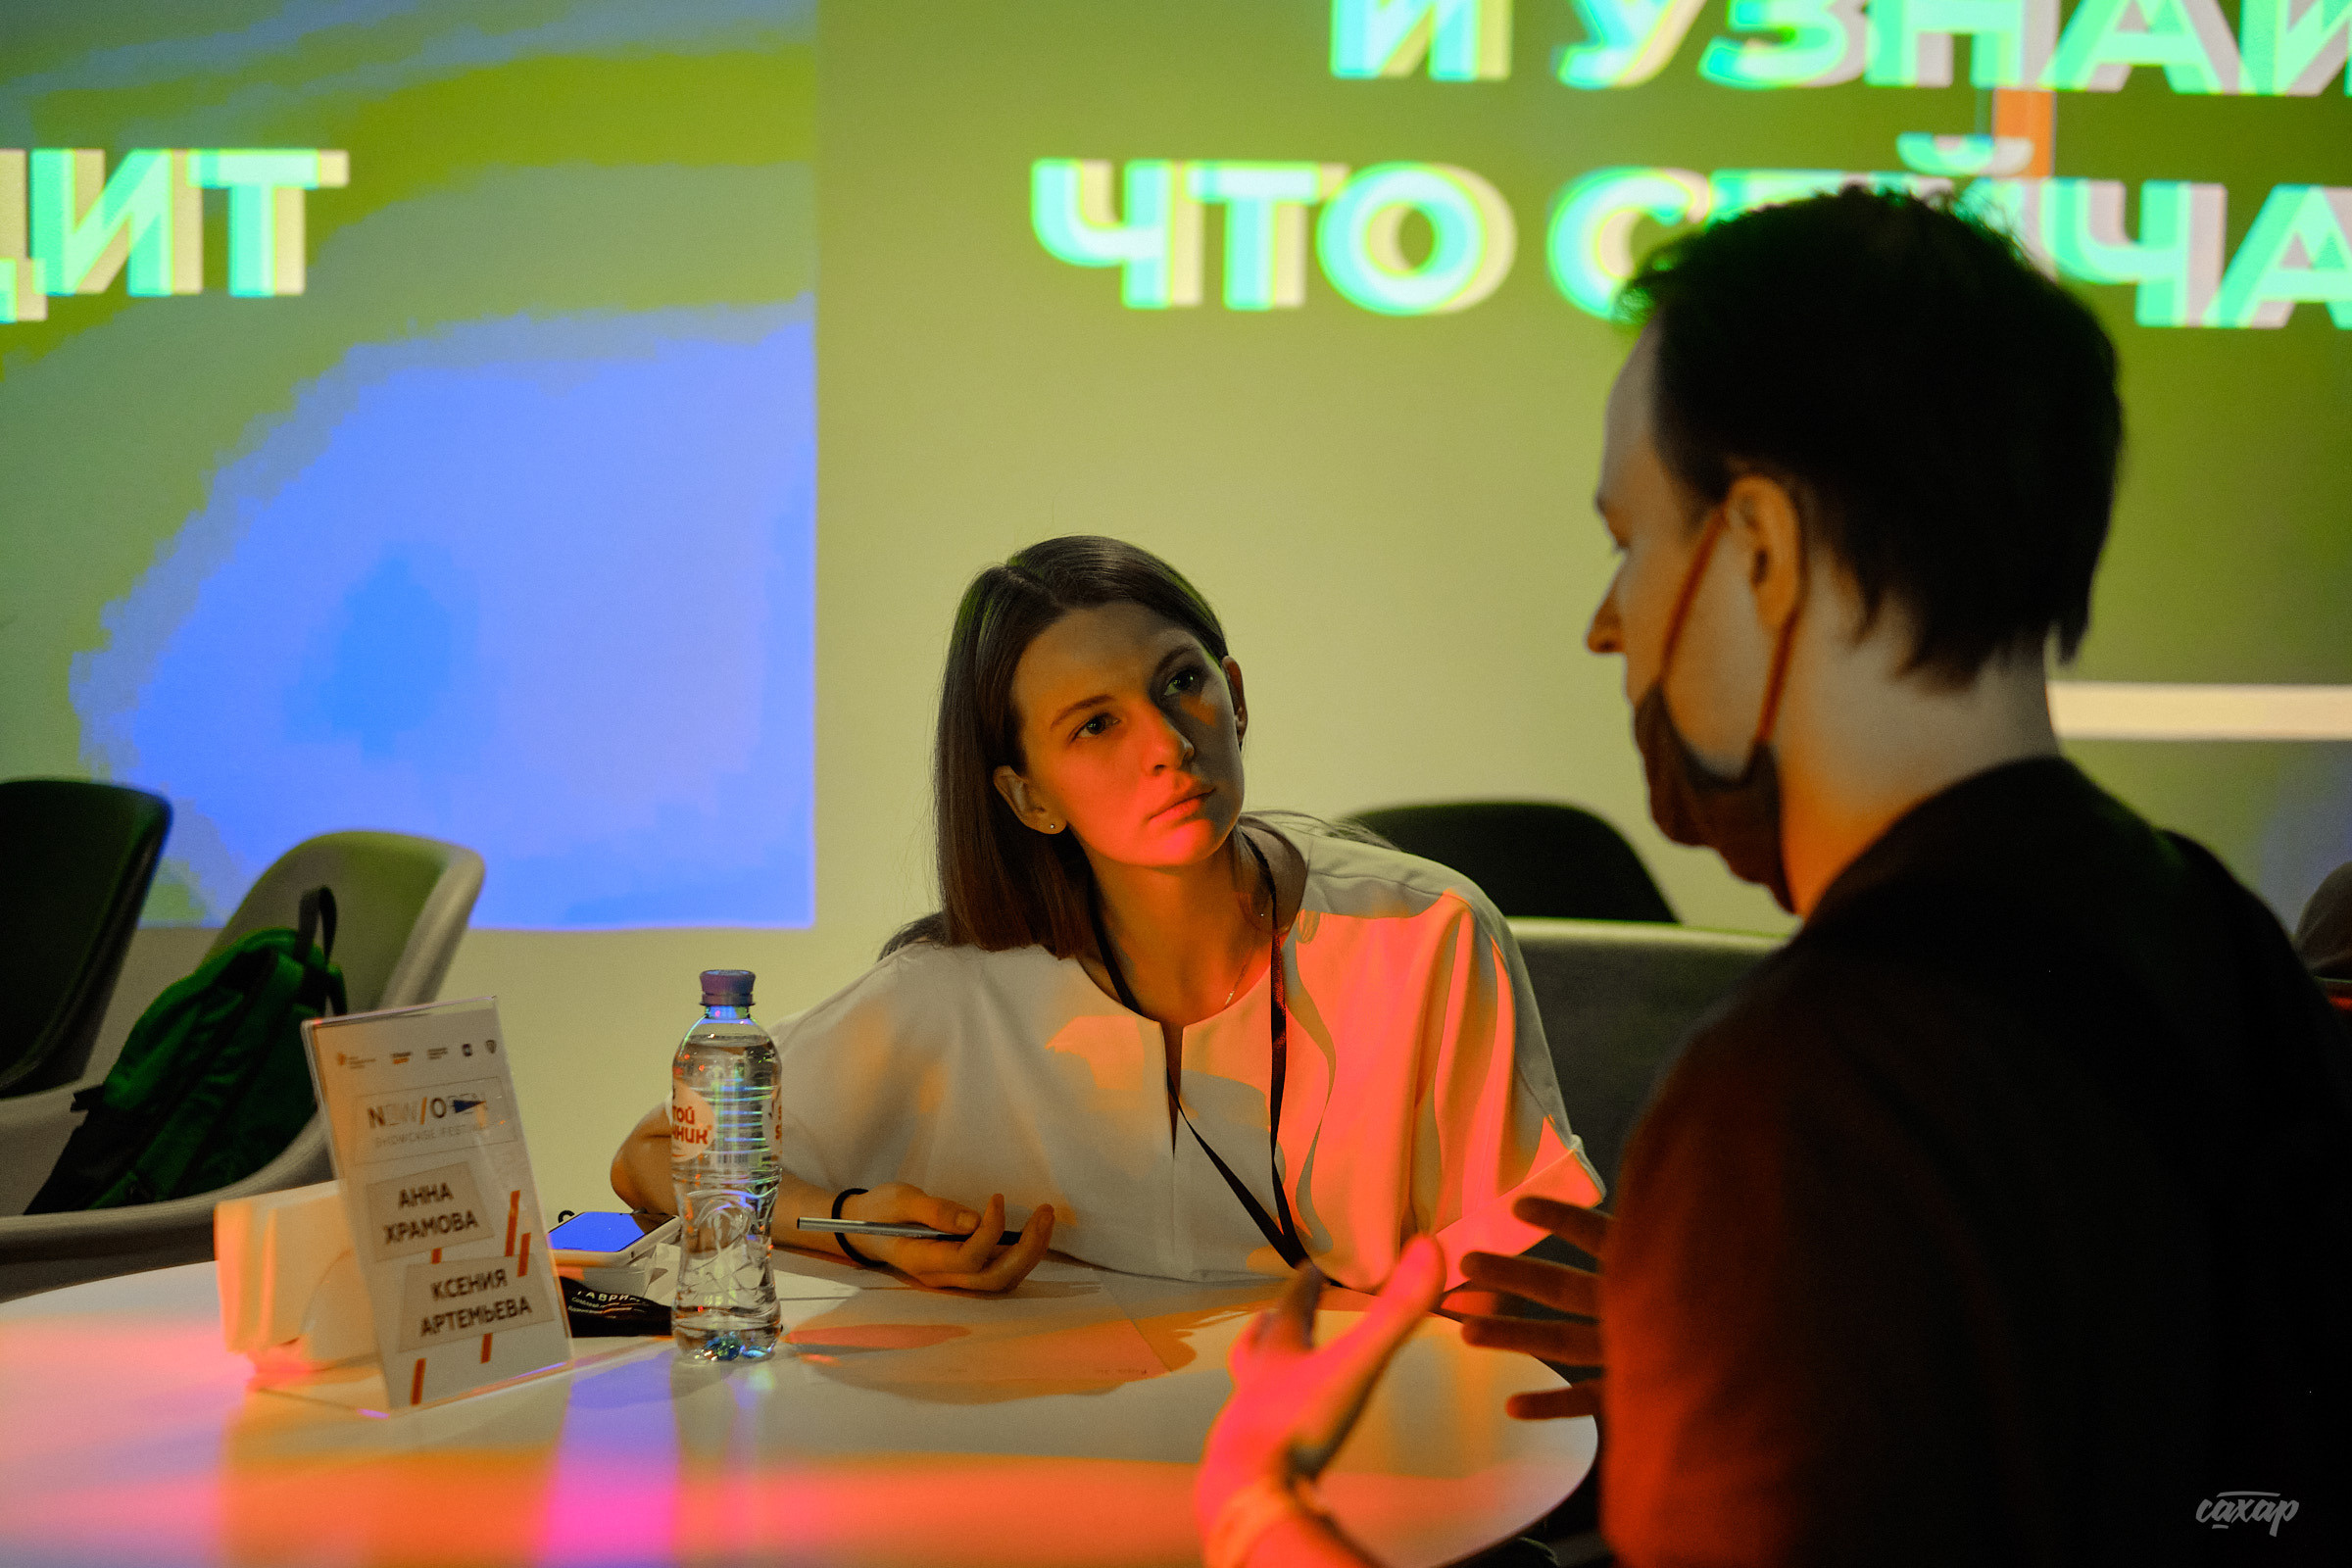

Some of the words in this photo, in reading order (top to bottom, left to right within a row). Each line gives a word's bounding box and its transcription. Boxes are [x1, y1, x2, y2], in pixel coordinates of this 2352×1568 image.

[1030, 158, 1517, 317] ЧТО
[1545, 132, 2352, 329] СЧА
[398, 1182, 454, 1209] АННА
[383, 1209, 479, 1245] ХРАМОВА
[430, 1268, 508, 1301] КСЕНИЯ
[419, 1296, 532, 1337] АРТЕМЬЕВА
